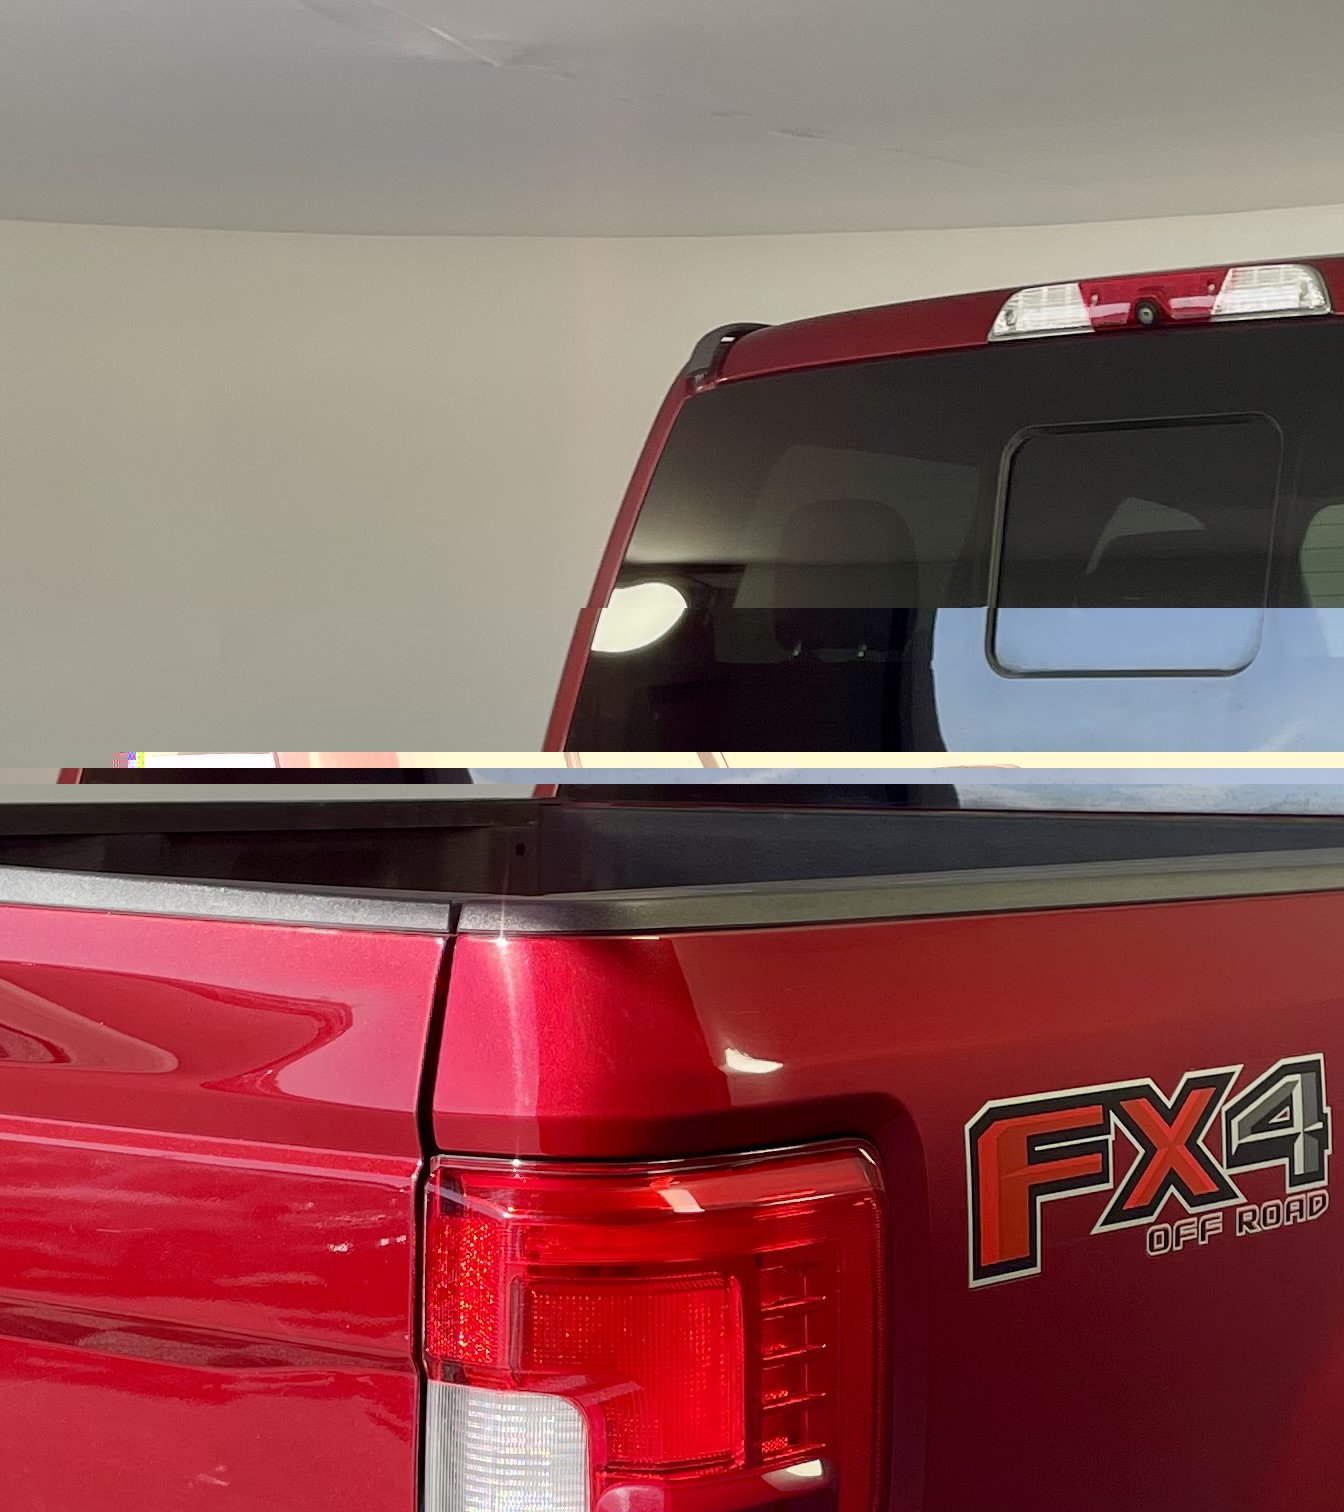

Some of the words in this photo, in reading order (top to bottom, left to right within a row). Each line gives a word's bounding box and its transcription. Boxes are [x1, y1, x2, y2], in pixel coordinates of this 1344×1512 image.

[964, 1052, 1332, 1288] FX4
[1146, 1212, 1223, 1257] OFF
[1235, 1189, 1330, 1237] ROAD
